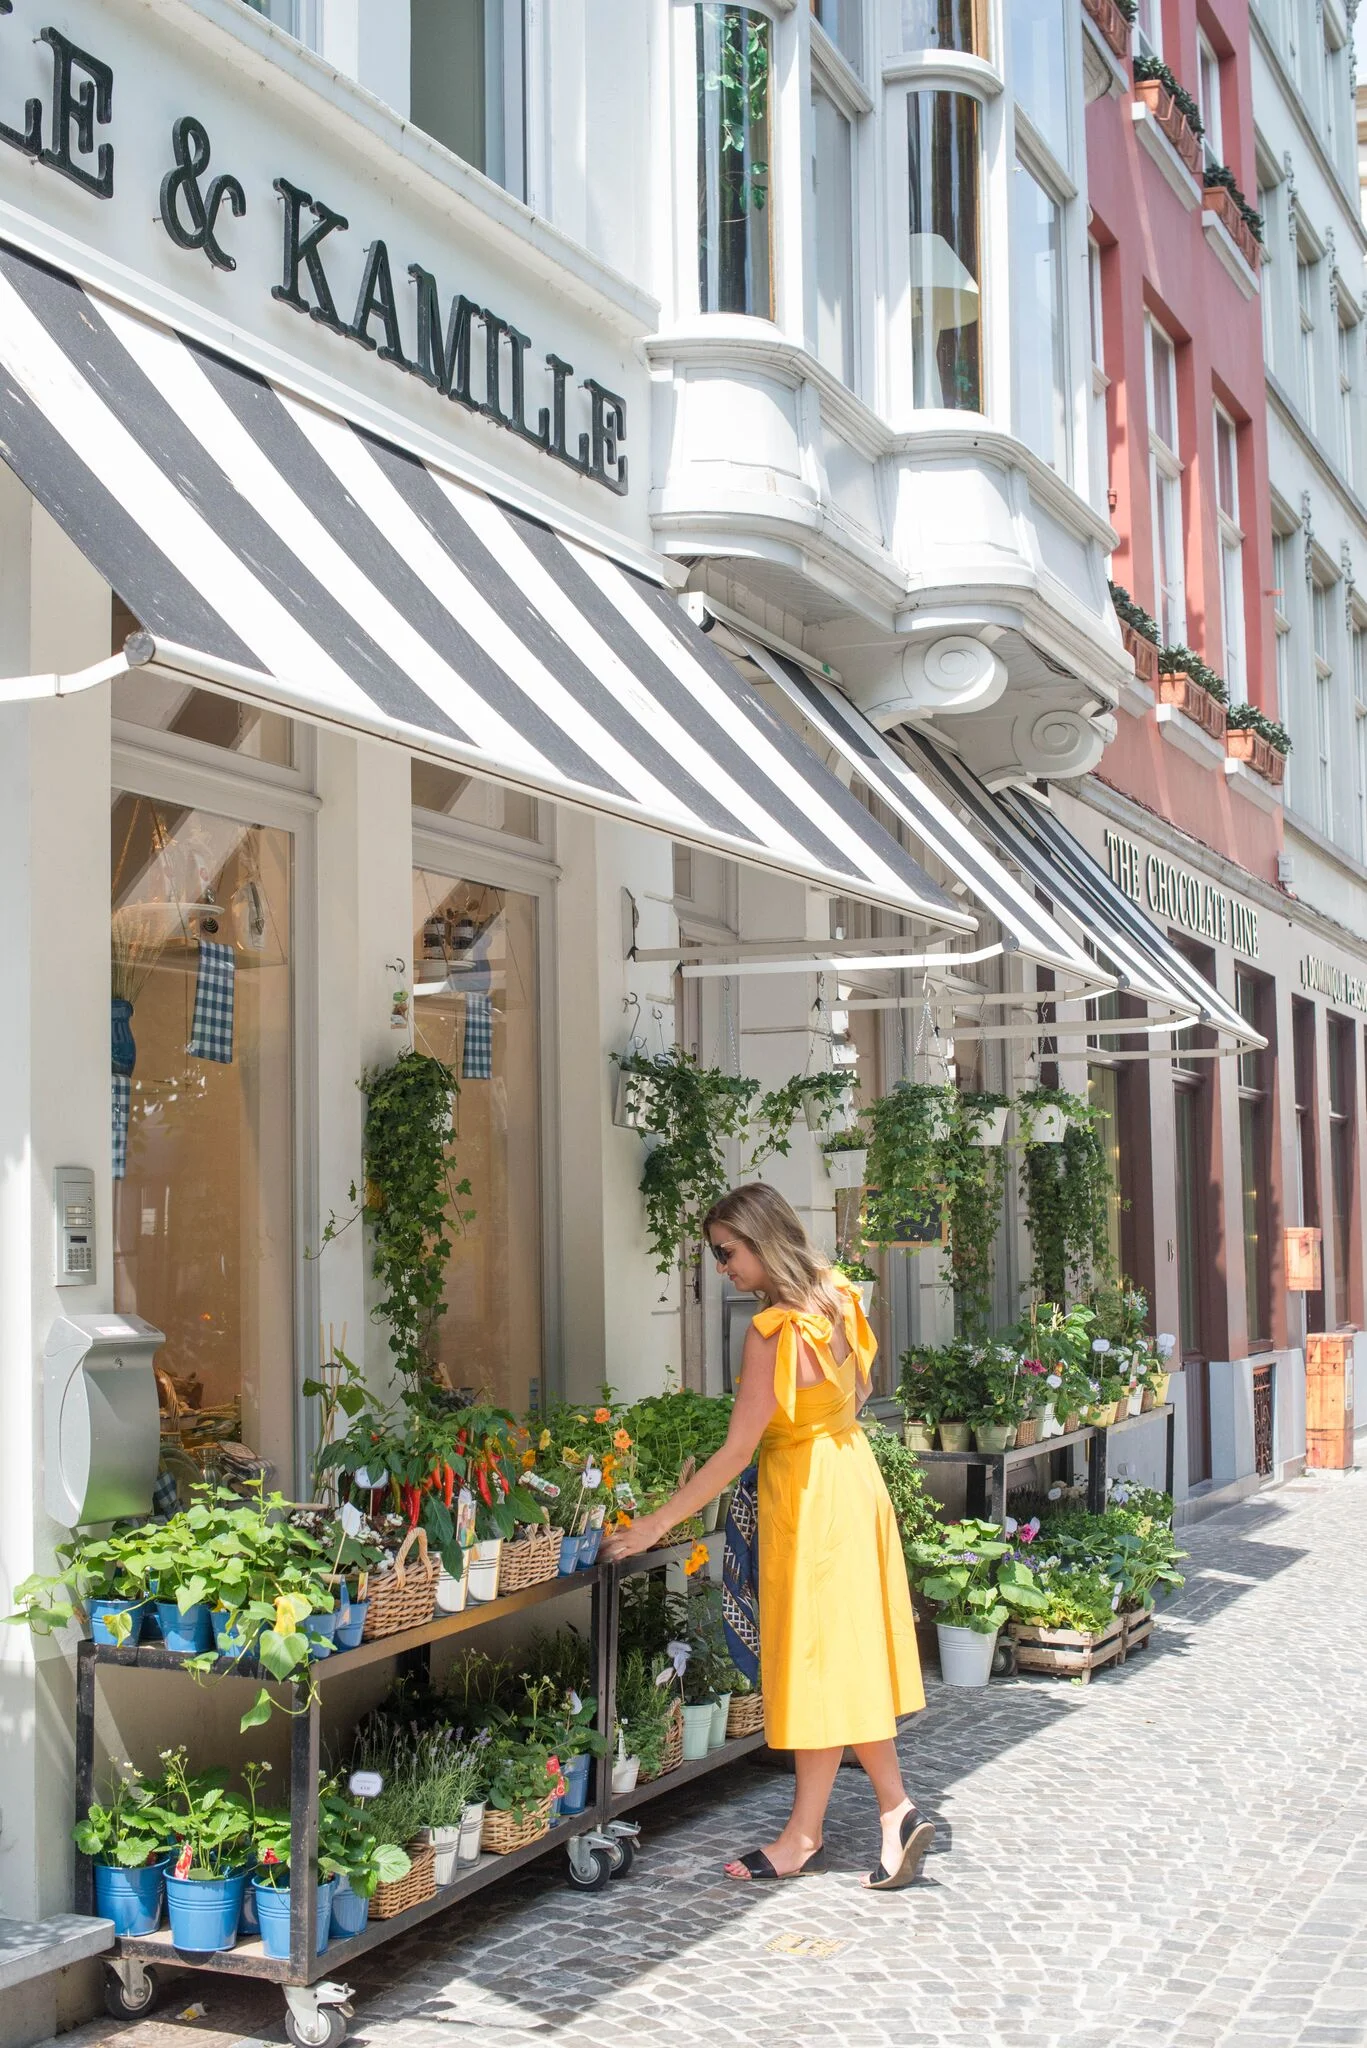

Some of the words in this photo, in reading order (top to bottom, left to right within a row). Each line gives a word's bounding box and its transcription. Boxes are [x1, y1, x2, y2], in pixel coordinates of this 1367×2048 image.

[160, 116, 247, 272] &
[271, 176, 628, 496] KAMILLE
[1104, 828, 1141, 903] THE
[1146, 854, 1228, 945] CHOCOLATE
[1230, 899, 1260, 959] LINE
